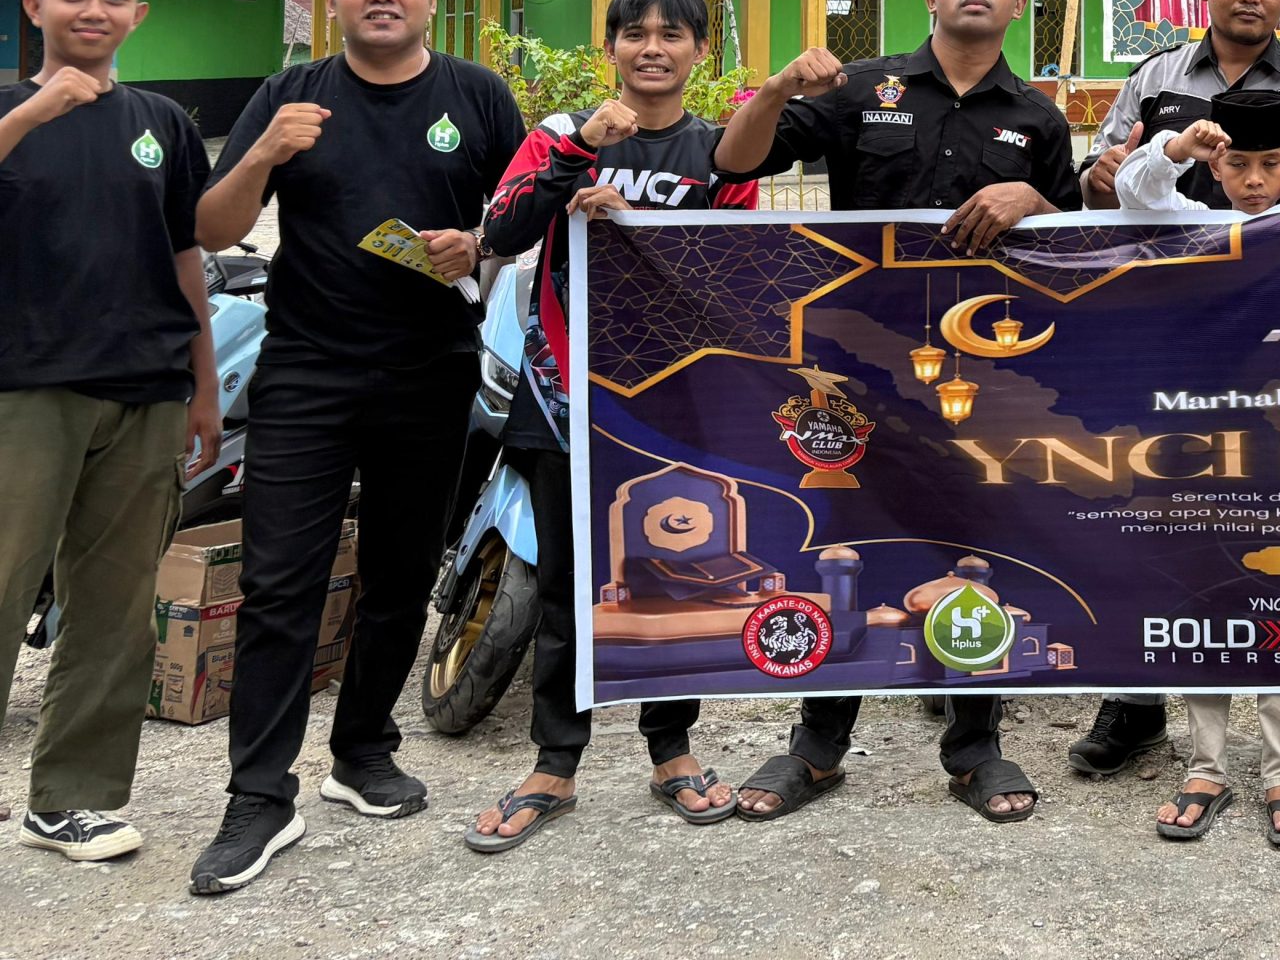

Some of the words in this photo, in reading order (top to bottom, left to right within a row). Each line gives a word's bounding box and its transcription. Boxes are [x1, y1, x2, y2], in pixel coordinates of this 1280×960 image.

[1159, 105, 1181, 115] ARRY
[866, 113, 909, 123] NAWAN
[808, 421, 843, 434] YAMAHA
[812, 441, 843, 449] CLUB
[946, 431, 1252, 484] YNCI
[1172, 490, 1262, 503] Serentak
[1169, 508, 1210, 521] apa
[1216, 507, 1269, 520] yang
[1121, 521, 1206, 535] menjadi
[1213, 521, 1255, 533] nilai
[758, 600, 812, 620] KARATE-DO
[747, 620, 760, 659] INSTITUT
[812, 612, 829, 655] NASIONAL
[1144, 617, 1256, 648] BOLD
[952, 640, 982, 650] Hplus
[763, 660, 813, 675] INKANAS
